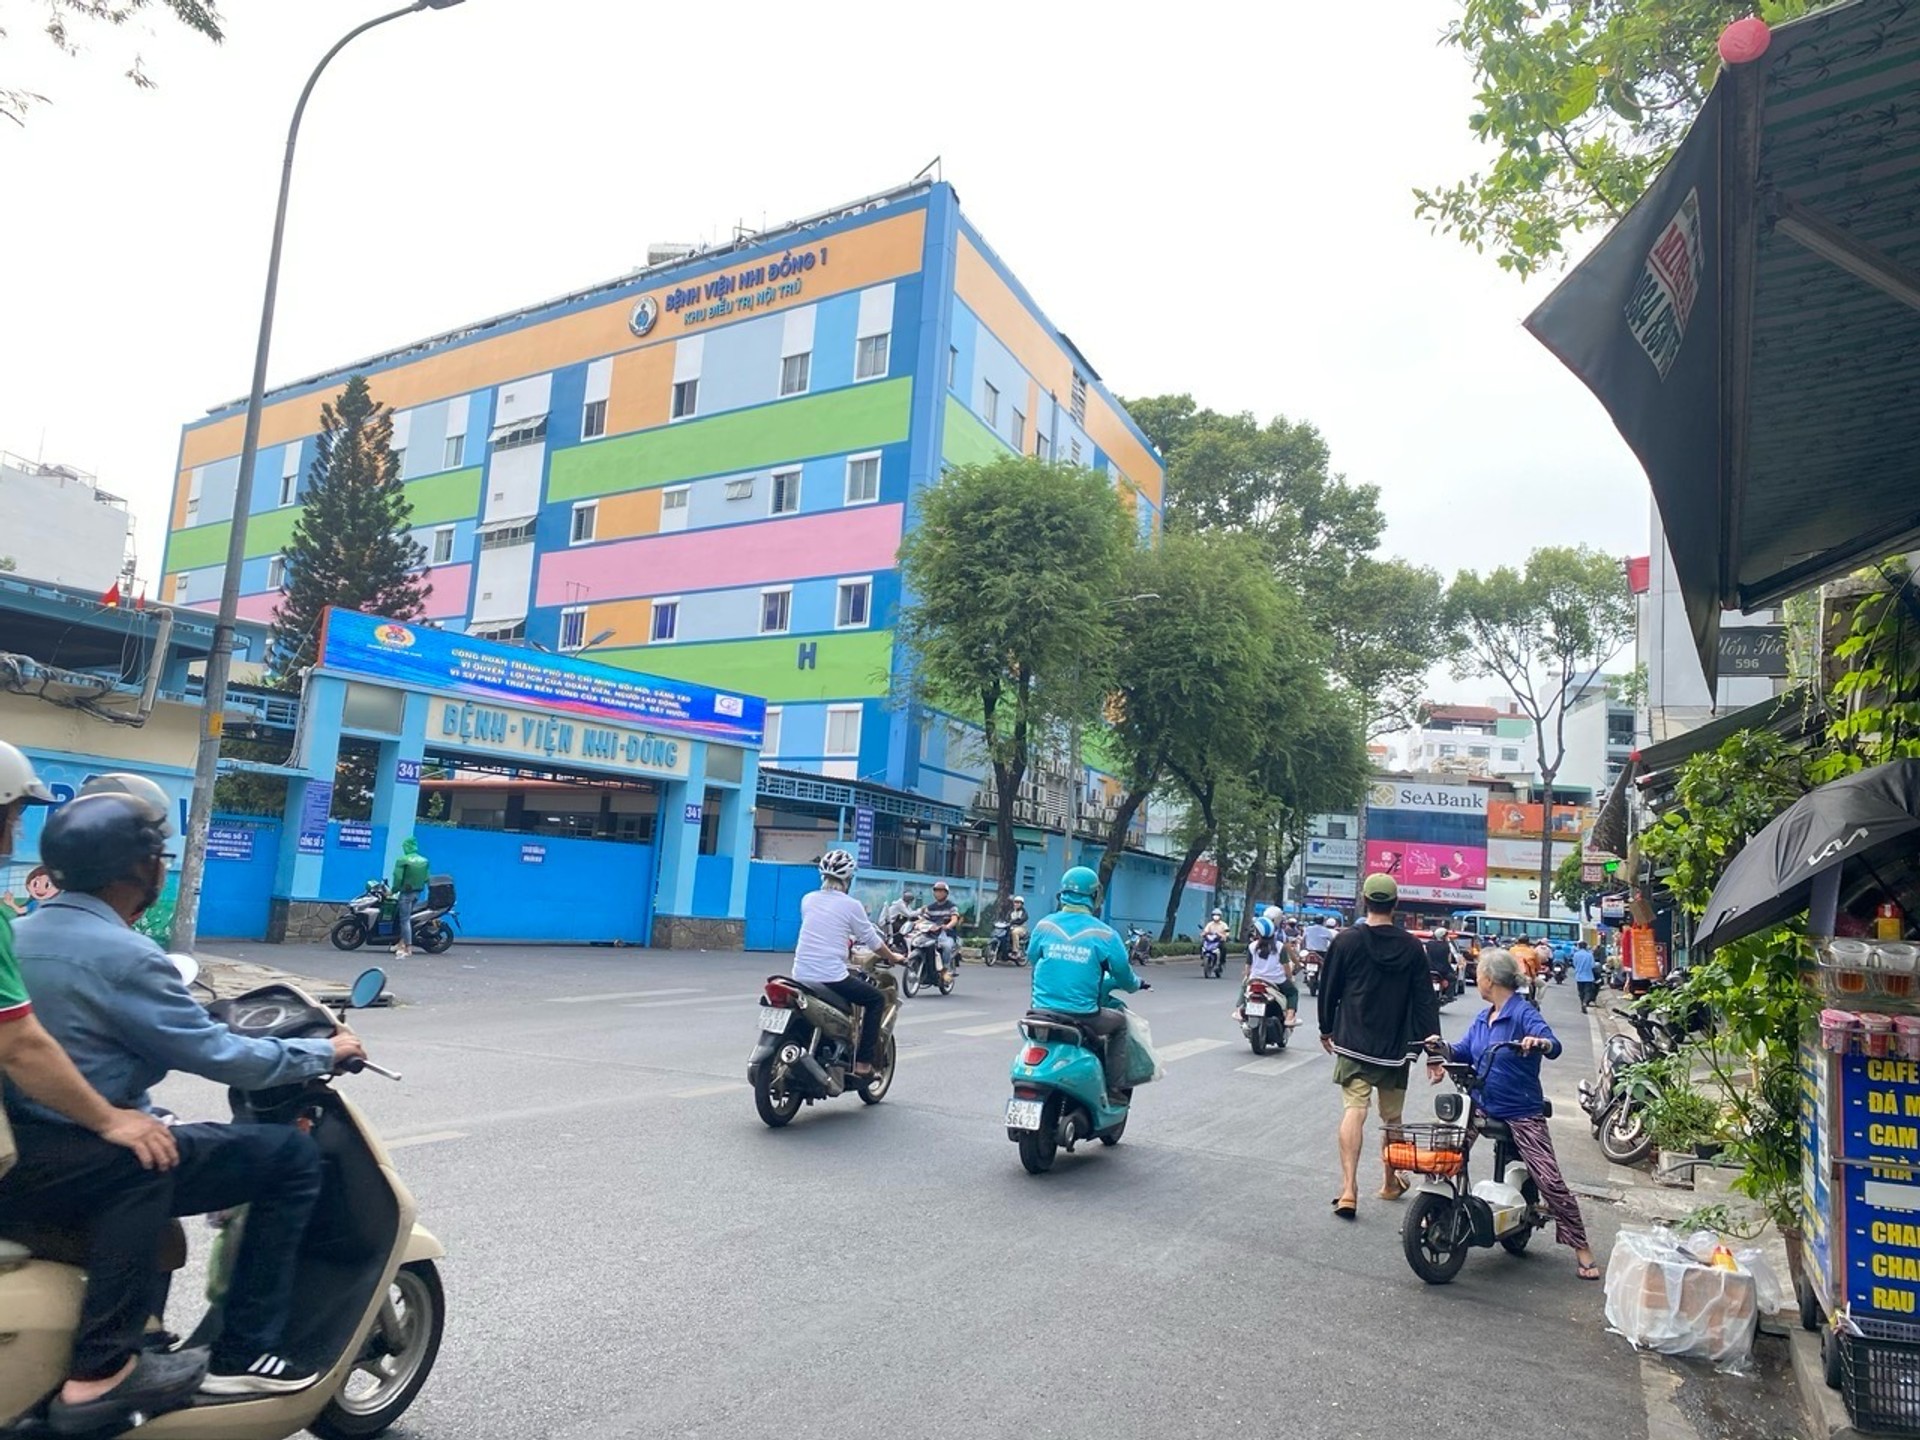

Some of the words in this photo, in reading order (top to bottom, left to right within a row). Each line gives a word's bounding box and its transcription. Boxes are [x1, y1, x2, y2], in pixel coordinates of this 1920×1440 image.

[666, 288, 701, 314] BỆNH
[704, 274, 736, 301] VIỆN
[739, 267, 765, 290] NHI
[768, 249, 816, 281] ĐỒNG
[820, 247, 827, 266] 1
[451, 648, 479, 660] CÔNG
[511, 660, 541, 673] THÀNH
[564, 671, 576, 680] HỒ
[798, 642, 817, 670] H
[1735, 658, 1759, 669] 596
[399, 763, 420, 778] 341
[1401, 789, 1483, 808] SeABank
[686, 806, 701, 819] 341
[1868, 1059, 1920, 1084] CAFE
[1868, 1089, 1899, 1115] ĐÁ
[1869, 1123, 1918, 1150] CAM
[1873, 1286, 1915, 1314] RAU
